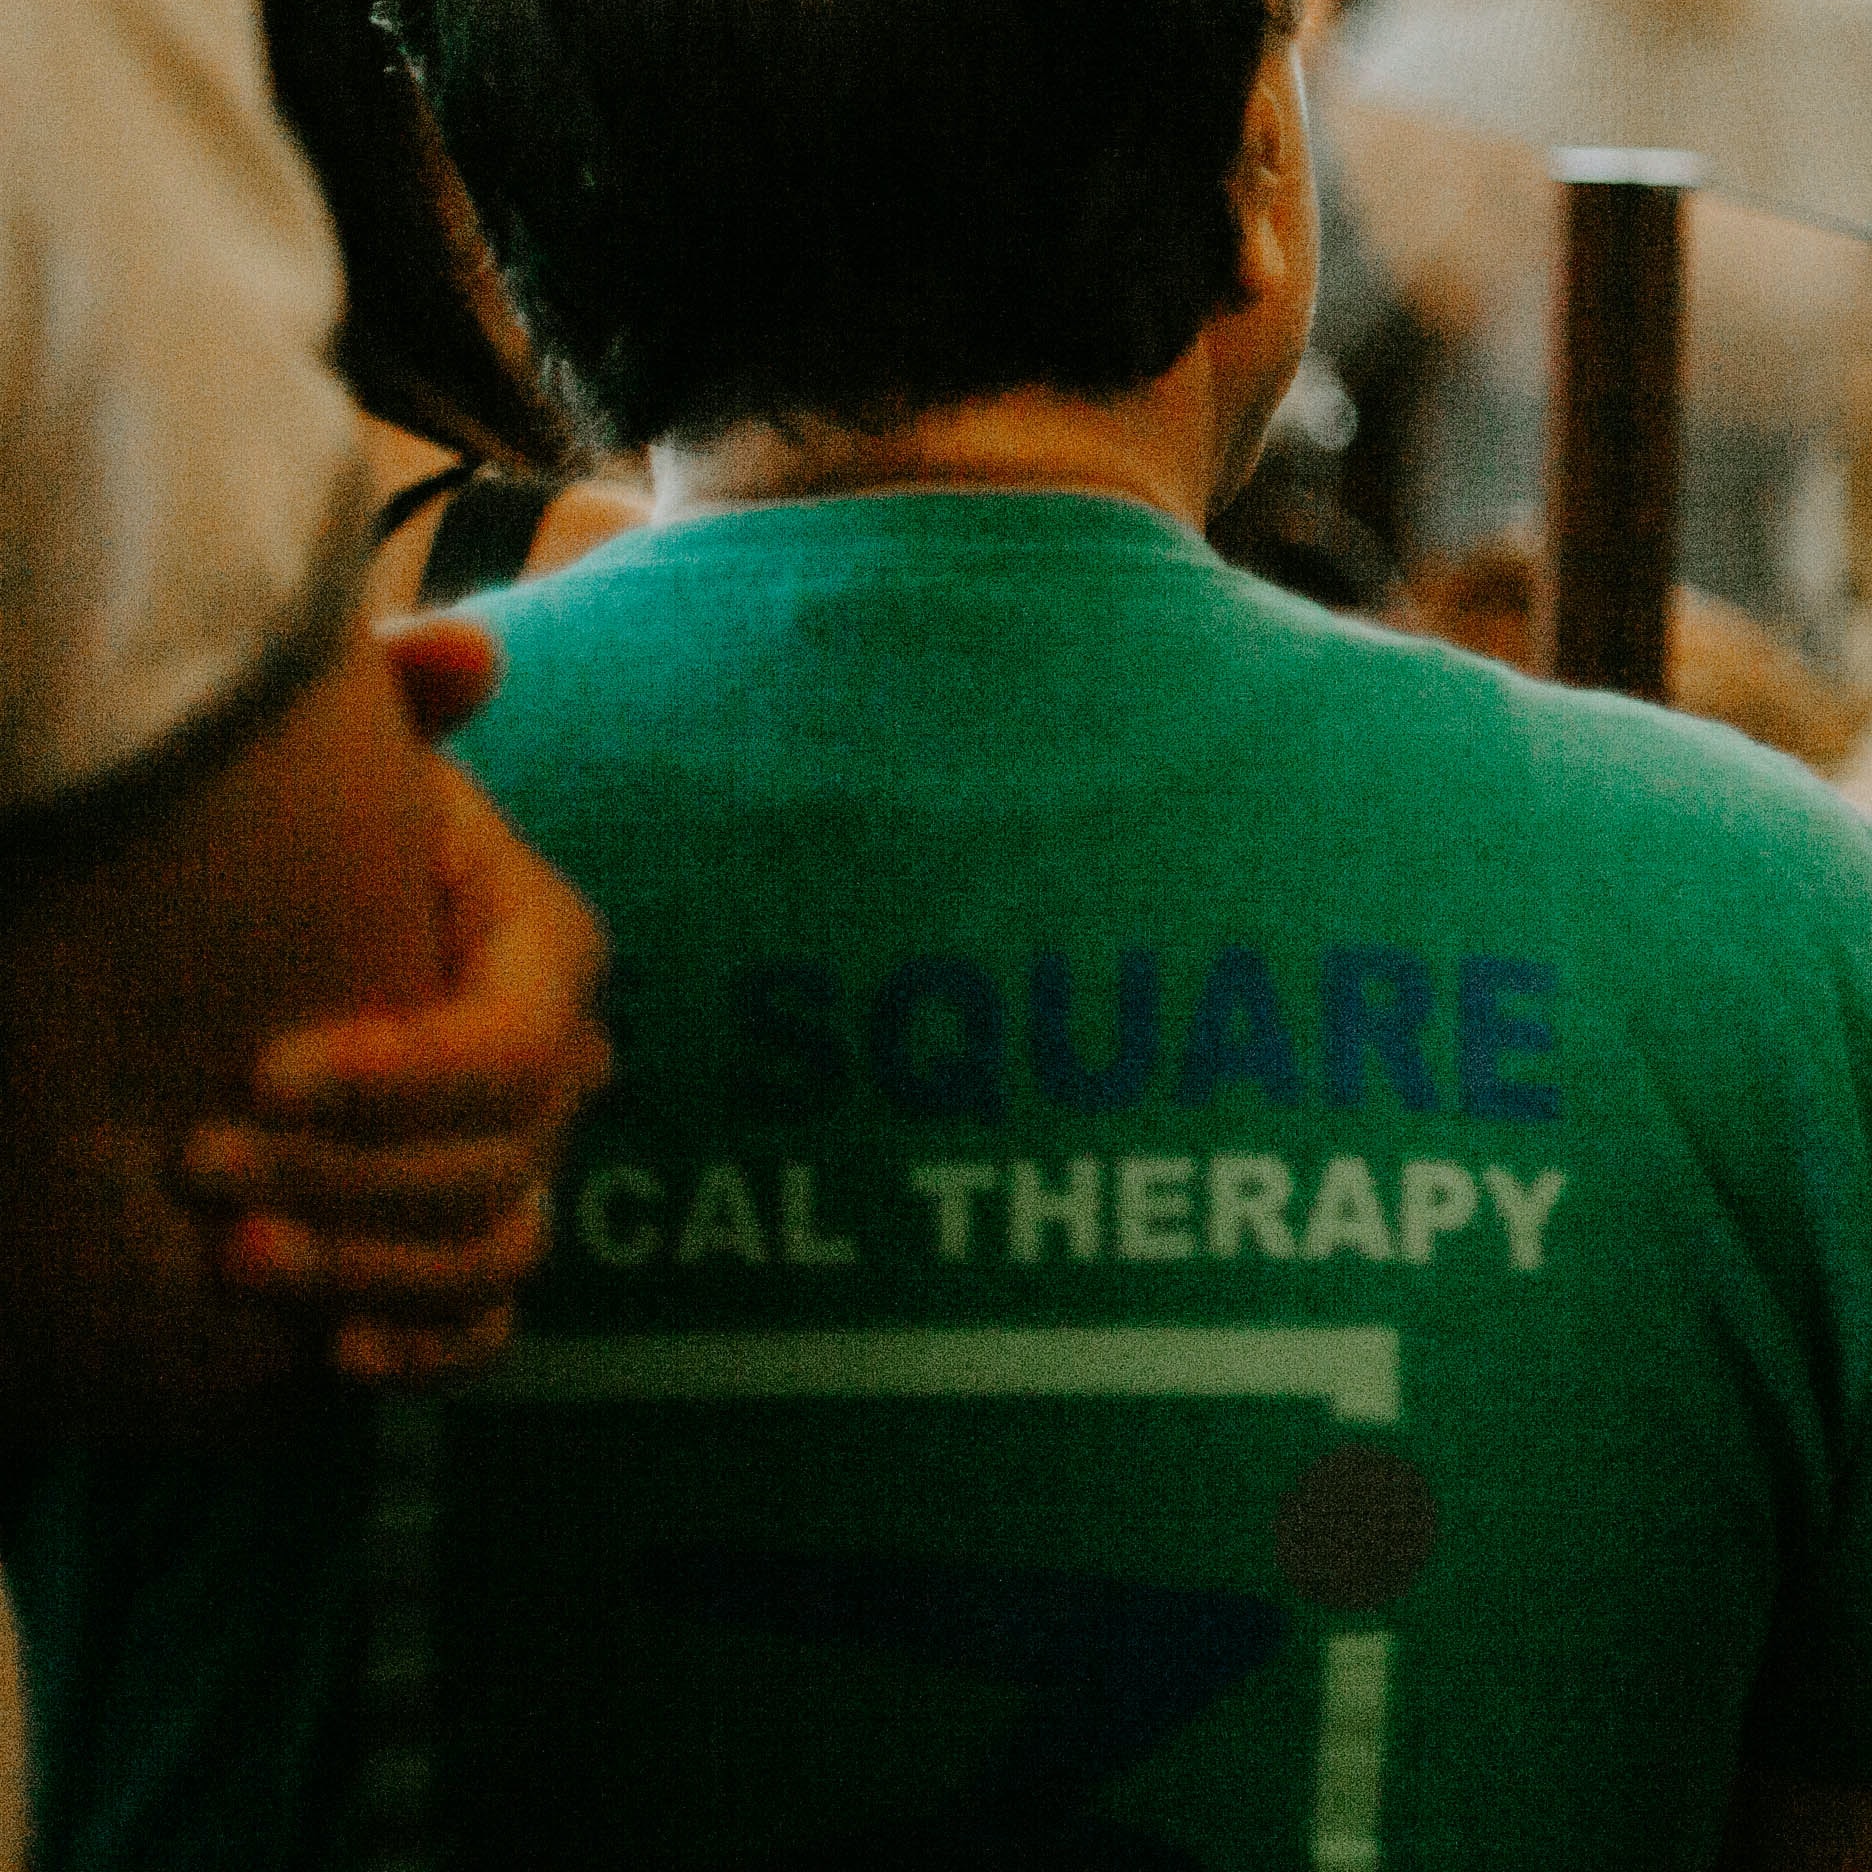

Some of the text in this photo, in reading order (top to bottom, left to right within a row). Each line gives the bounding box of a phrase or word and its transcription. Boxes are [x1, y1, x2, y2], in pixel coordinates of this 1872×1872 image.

[728, 944, 1567, 1124] SQUARE
[552, 1152, 1569, 1272] CAL THERAPY
